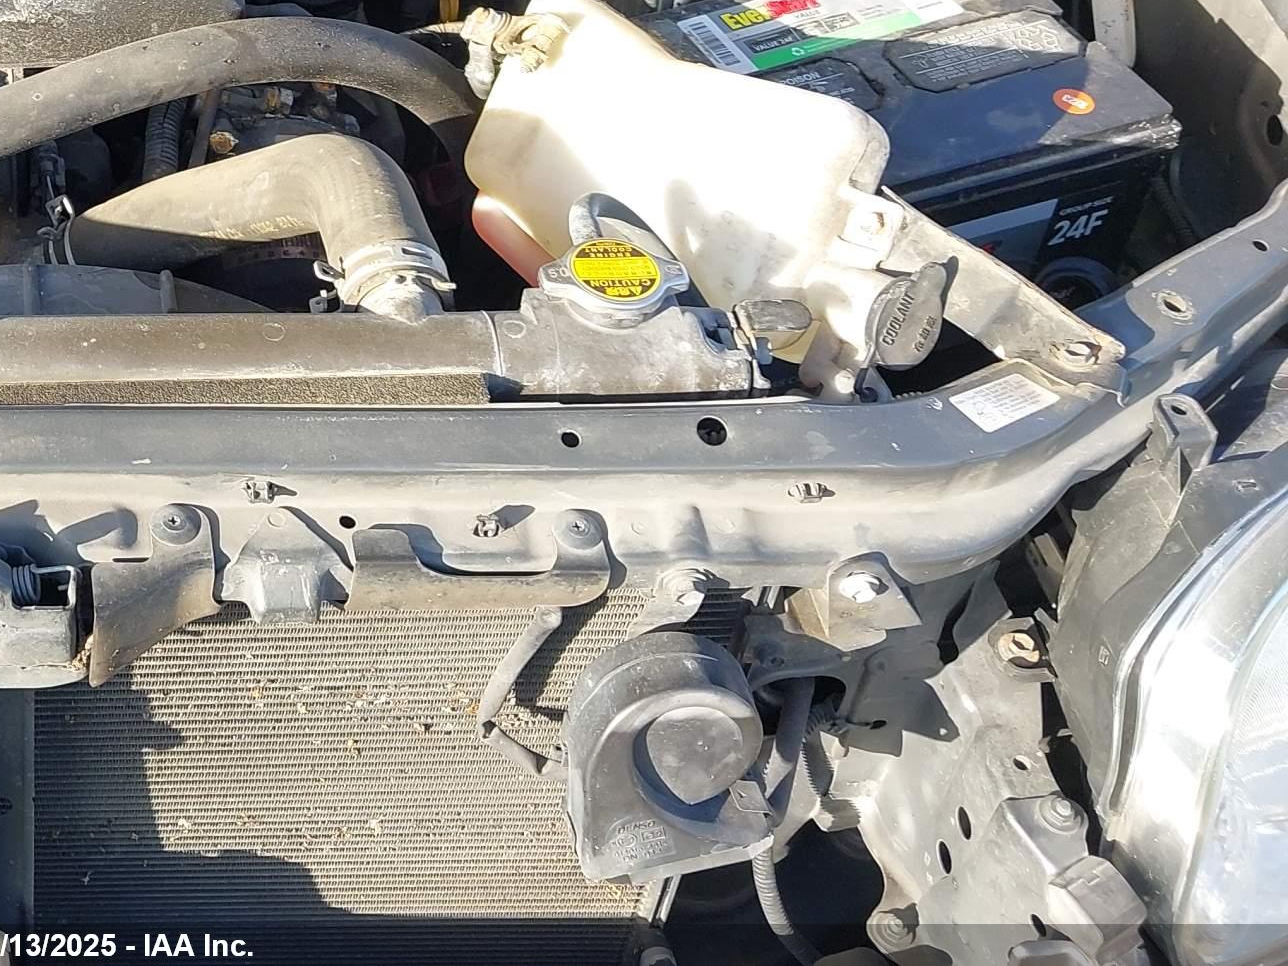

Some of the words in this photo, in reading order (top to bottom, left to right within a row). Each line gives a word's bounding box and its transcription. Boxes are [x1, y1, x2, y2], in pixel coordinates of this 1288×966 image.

[794, 9, 821, 19] VALUE
[1047, 209, 1109, 246] 24F
[584, 245, 633, 253] COOLANT
[589, 279, 651, 288] CAUTION
[881, 291, 916, 346] COOLANT
